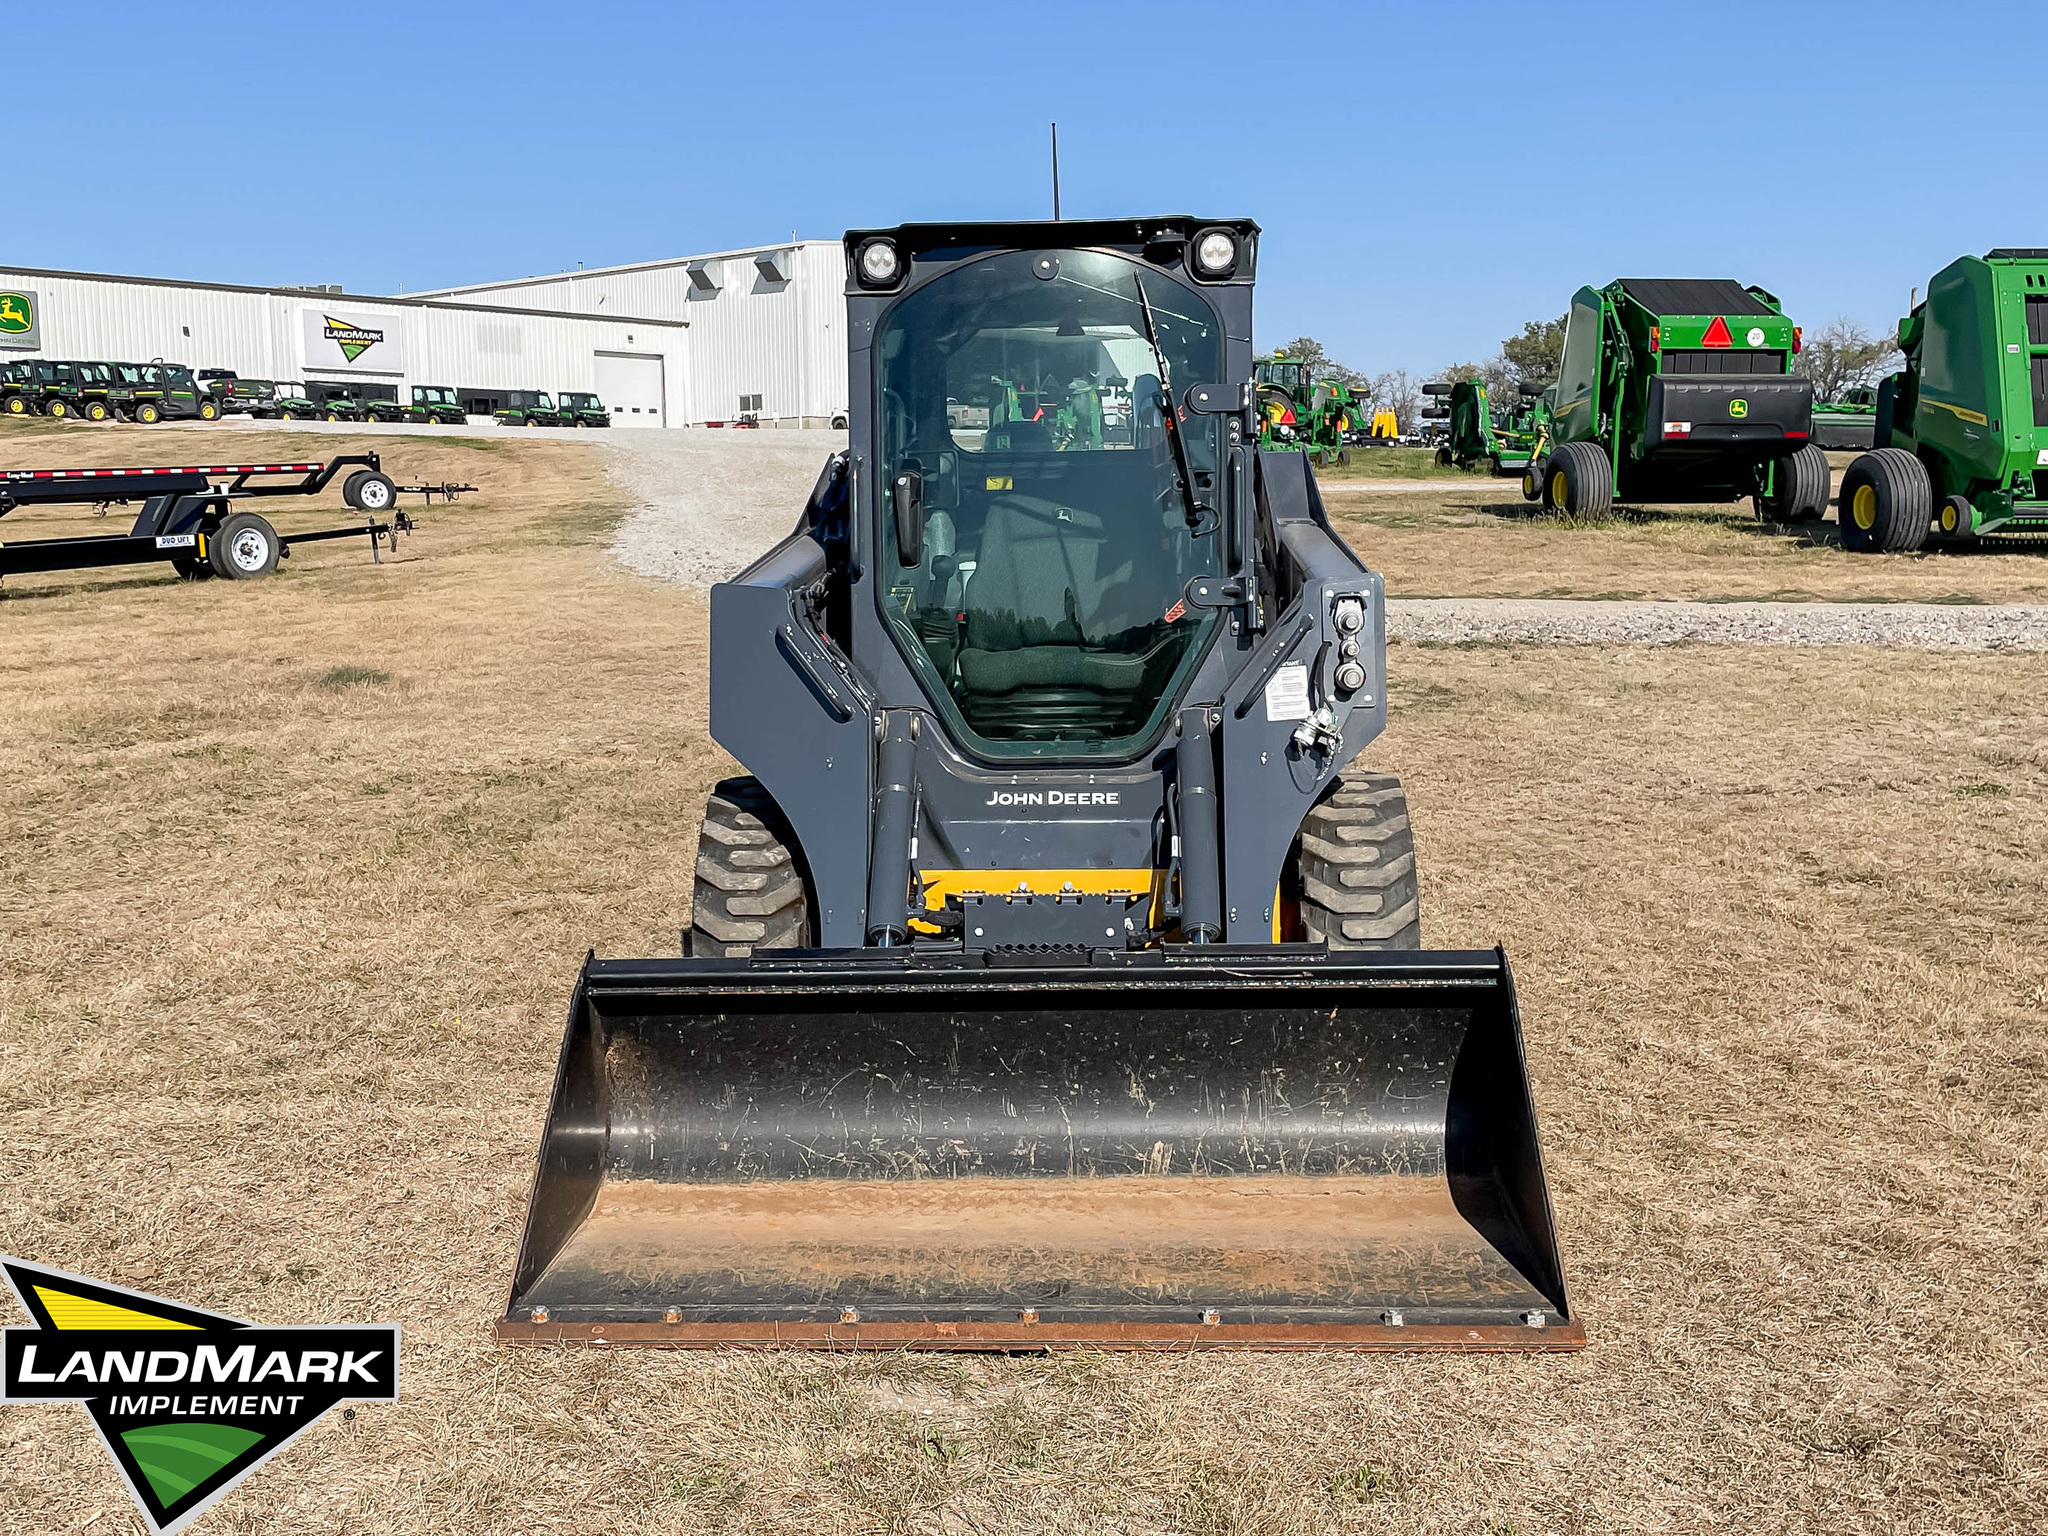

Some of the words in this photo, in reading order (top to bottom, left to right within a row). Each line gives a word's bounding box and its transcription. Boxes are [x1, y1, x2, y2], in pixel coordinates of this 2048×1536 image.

[325, 329, 381, 340] LANDMARK
[986, 791, 1043, 805] JOHN
[1048, 790, 1119, 805] DEERE
